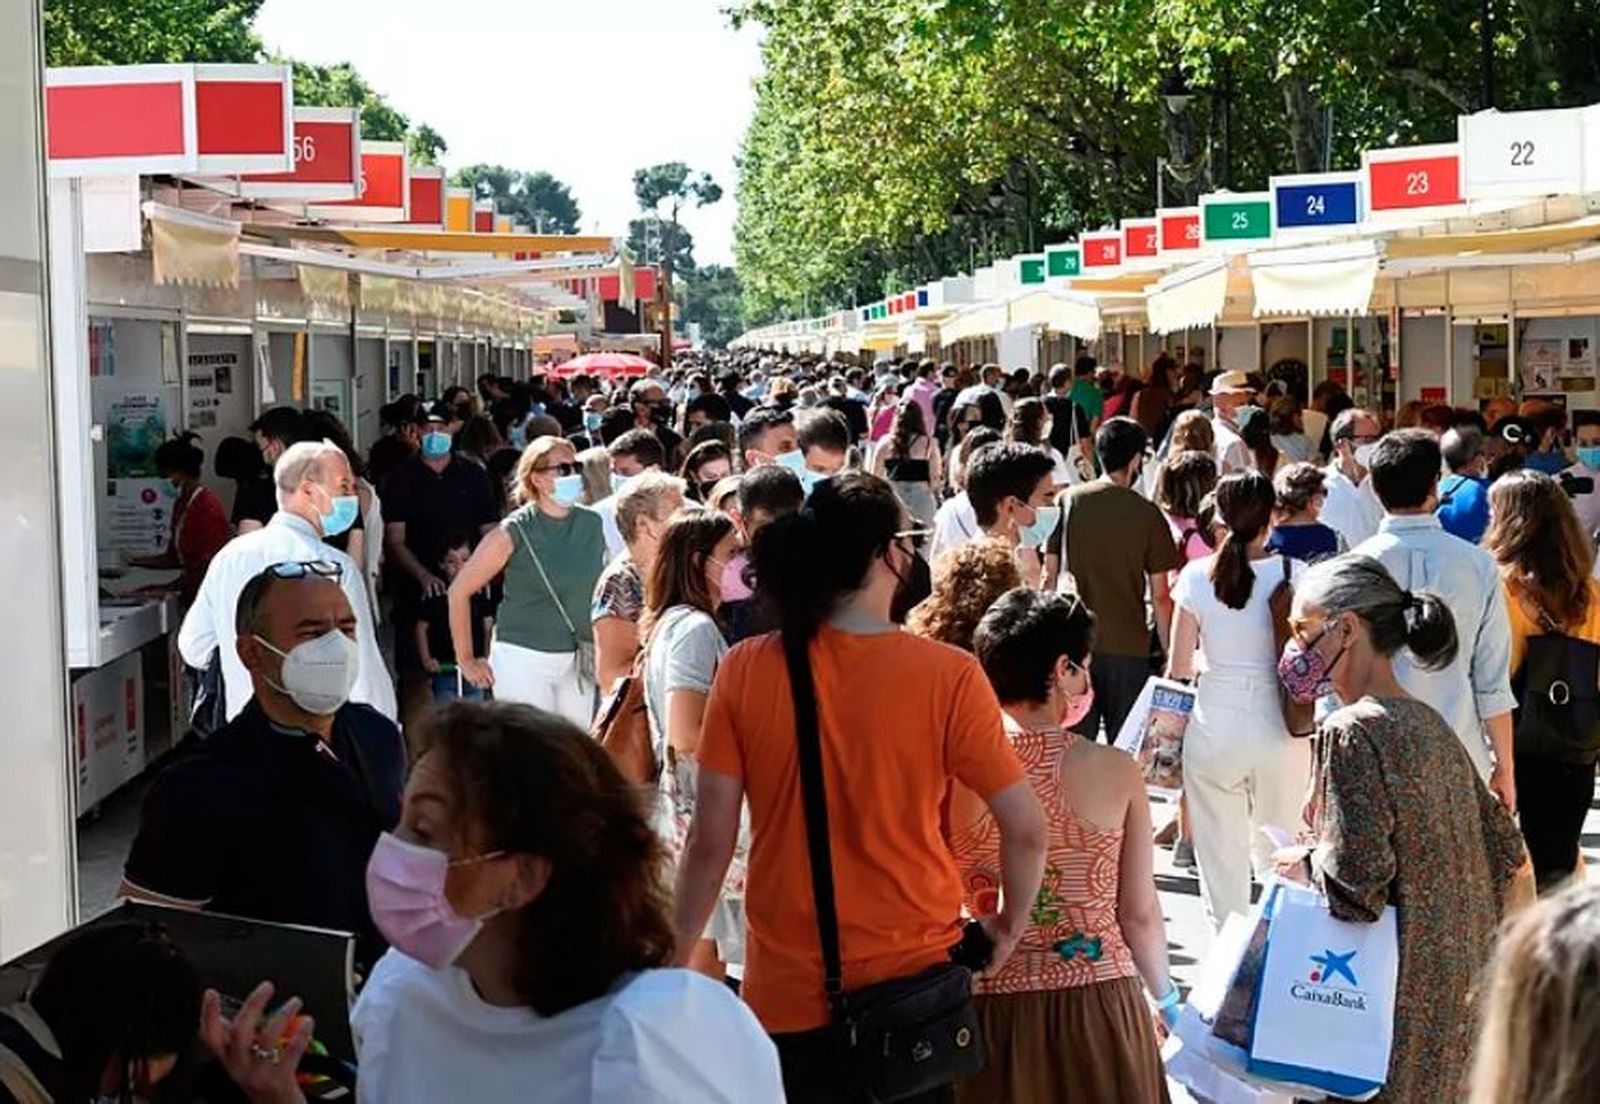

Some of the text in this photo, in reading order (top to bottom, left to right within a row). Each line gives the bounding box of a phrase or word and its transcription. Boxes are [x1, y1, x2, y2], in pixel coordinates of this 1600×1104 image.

[294, 136, 316, 162] 56
[1510, 140, 1535, 166] 22
[1407, 172, 1429, 194] 23
[1307, 195, 1325, 215] 24
[1231, 211, 1249, 229] 25
[1291, 985, 1367, 1011] CaixaBank
